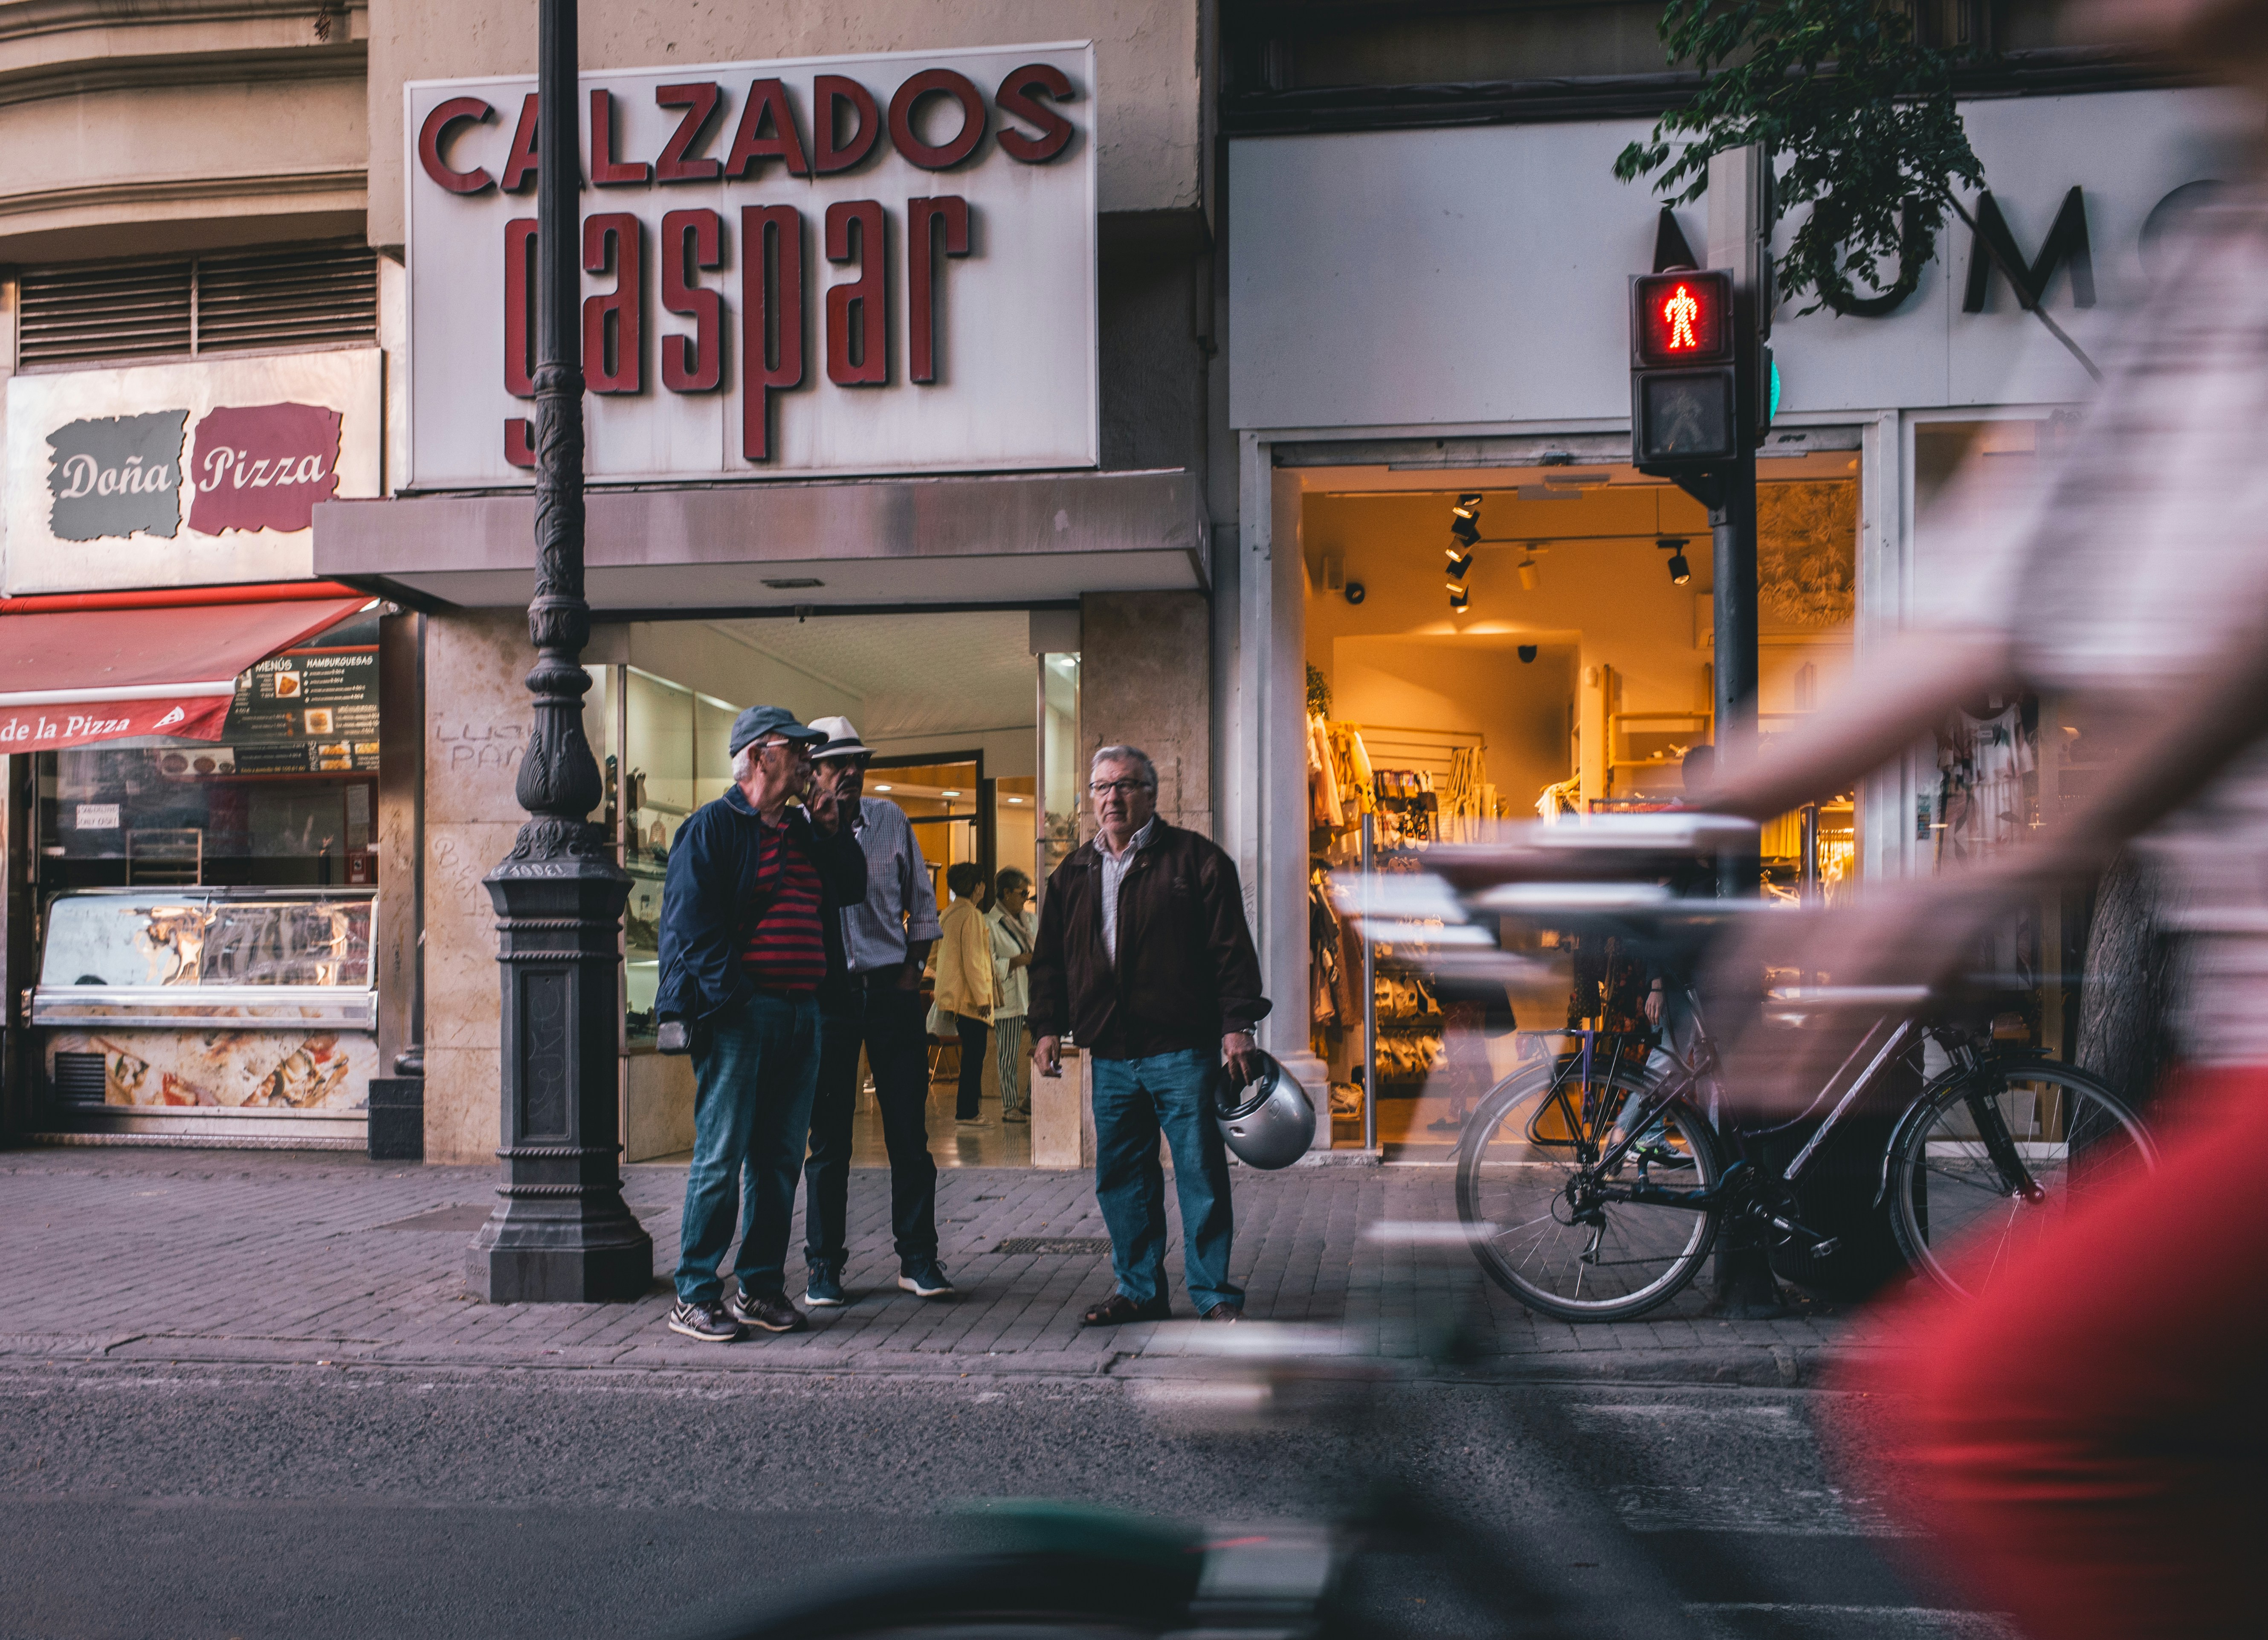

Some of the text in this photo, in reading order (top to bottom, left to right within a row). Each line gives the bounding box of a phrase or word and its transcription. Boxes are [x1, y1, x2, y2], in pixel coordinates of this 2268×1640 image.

[60, 446, 326, 499] Doña Pizza
[307, 655, 373, 668] HAMBURGUESAS
[0, 716, 130, 742] de la Pizza
